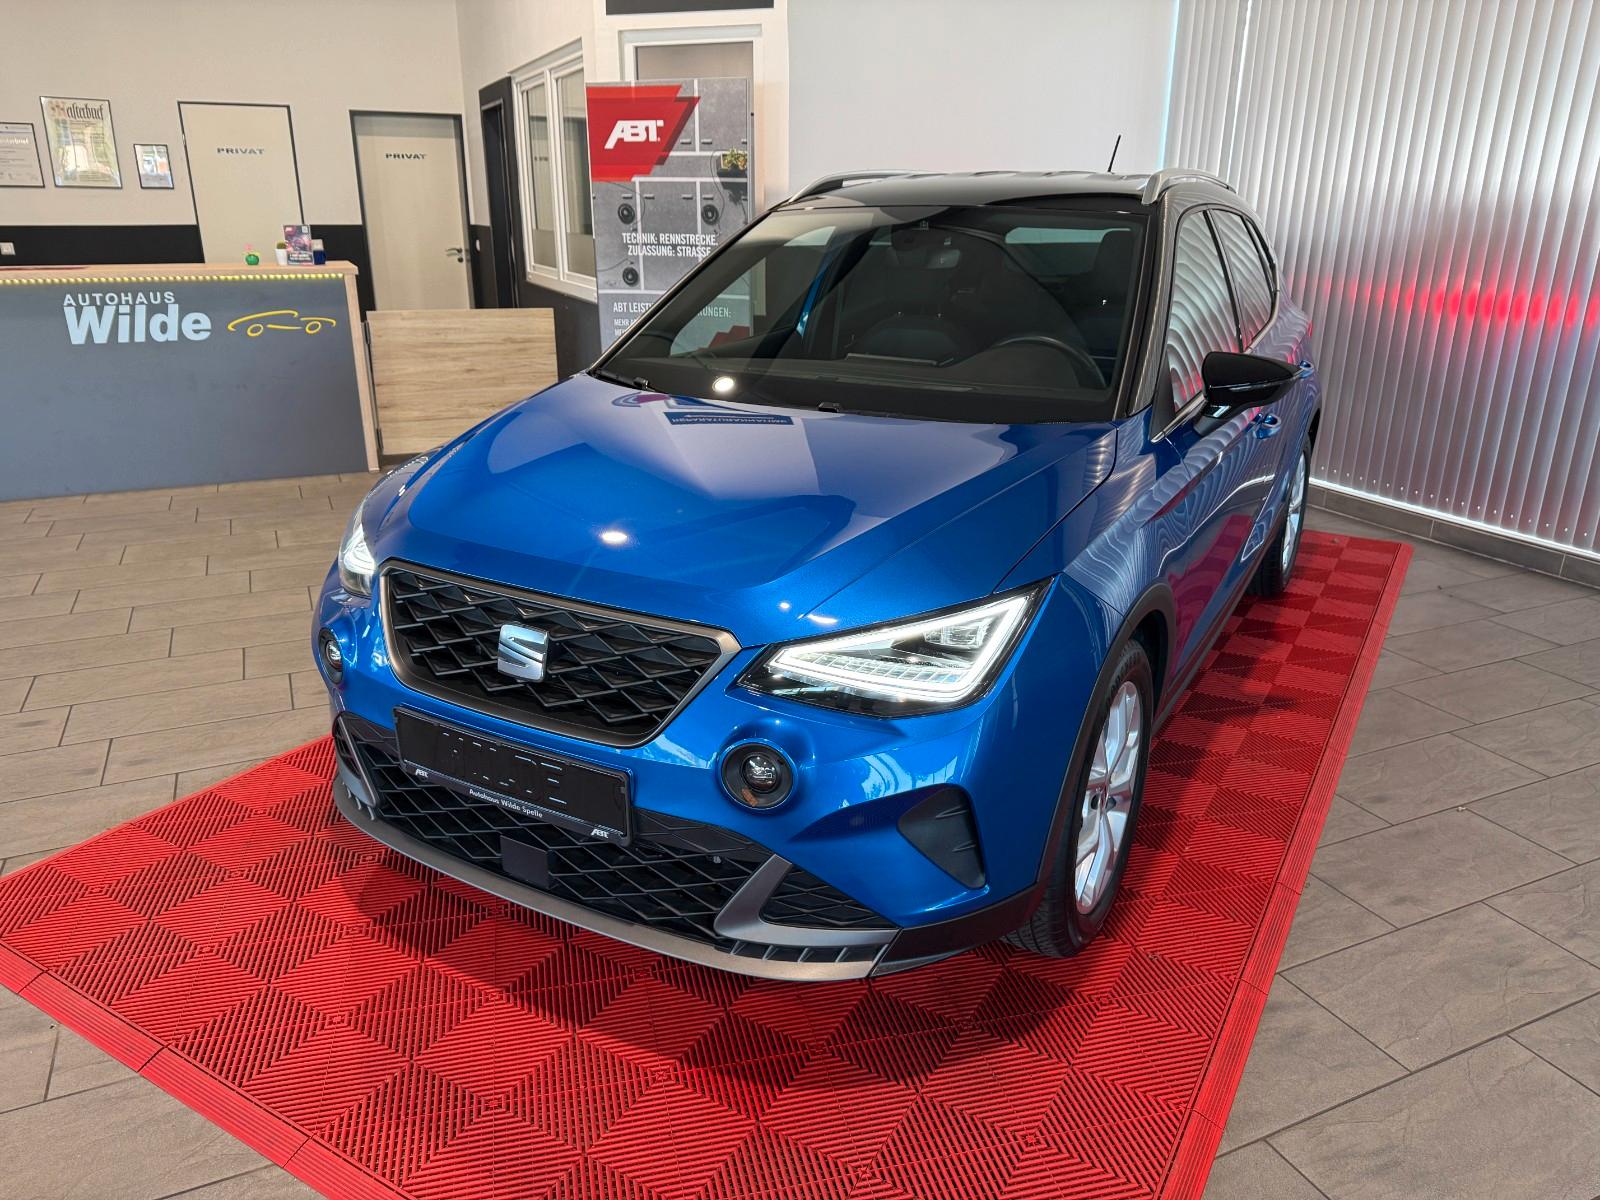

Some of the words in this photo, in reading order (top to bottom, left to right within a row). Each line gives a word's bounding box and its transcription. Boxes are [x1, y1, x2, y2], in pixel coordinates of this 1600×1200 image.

[604, 119, 664, 150] ABT
[217, 147, 265, 155] PRIVAT
[385, 152, 428, 160] PRIVAT
[622, 232, 658, 244] TECHNIK:
[659, 233, 718, 246] RENNSTRECKE.
[628, 245, 676, 256] ZULASSUNG:
[63, 291, 176, 306] AUTOHAUS
[613, 302, 628, 313] ABT
[63, 304, 212, 345] Wilde
[469, 788, 500, 805] Autohaus
[500, 798, 521, 811] Wilde
